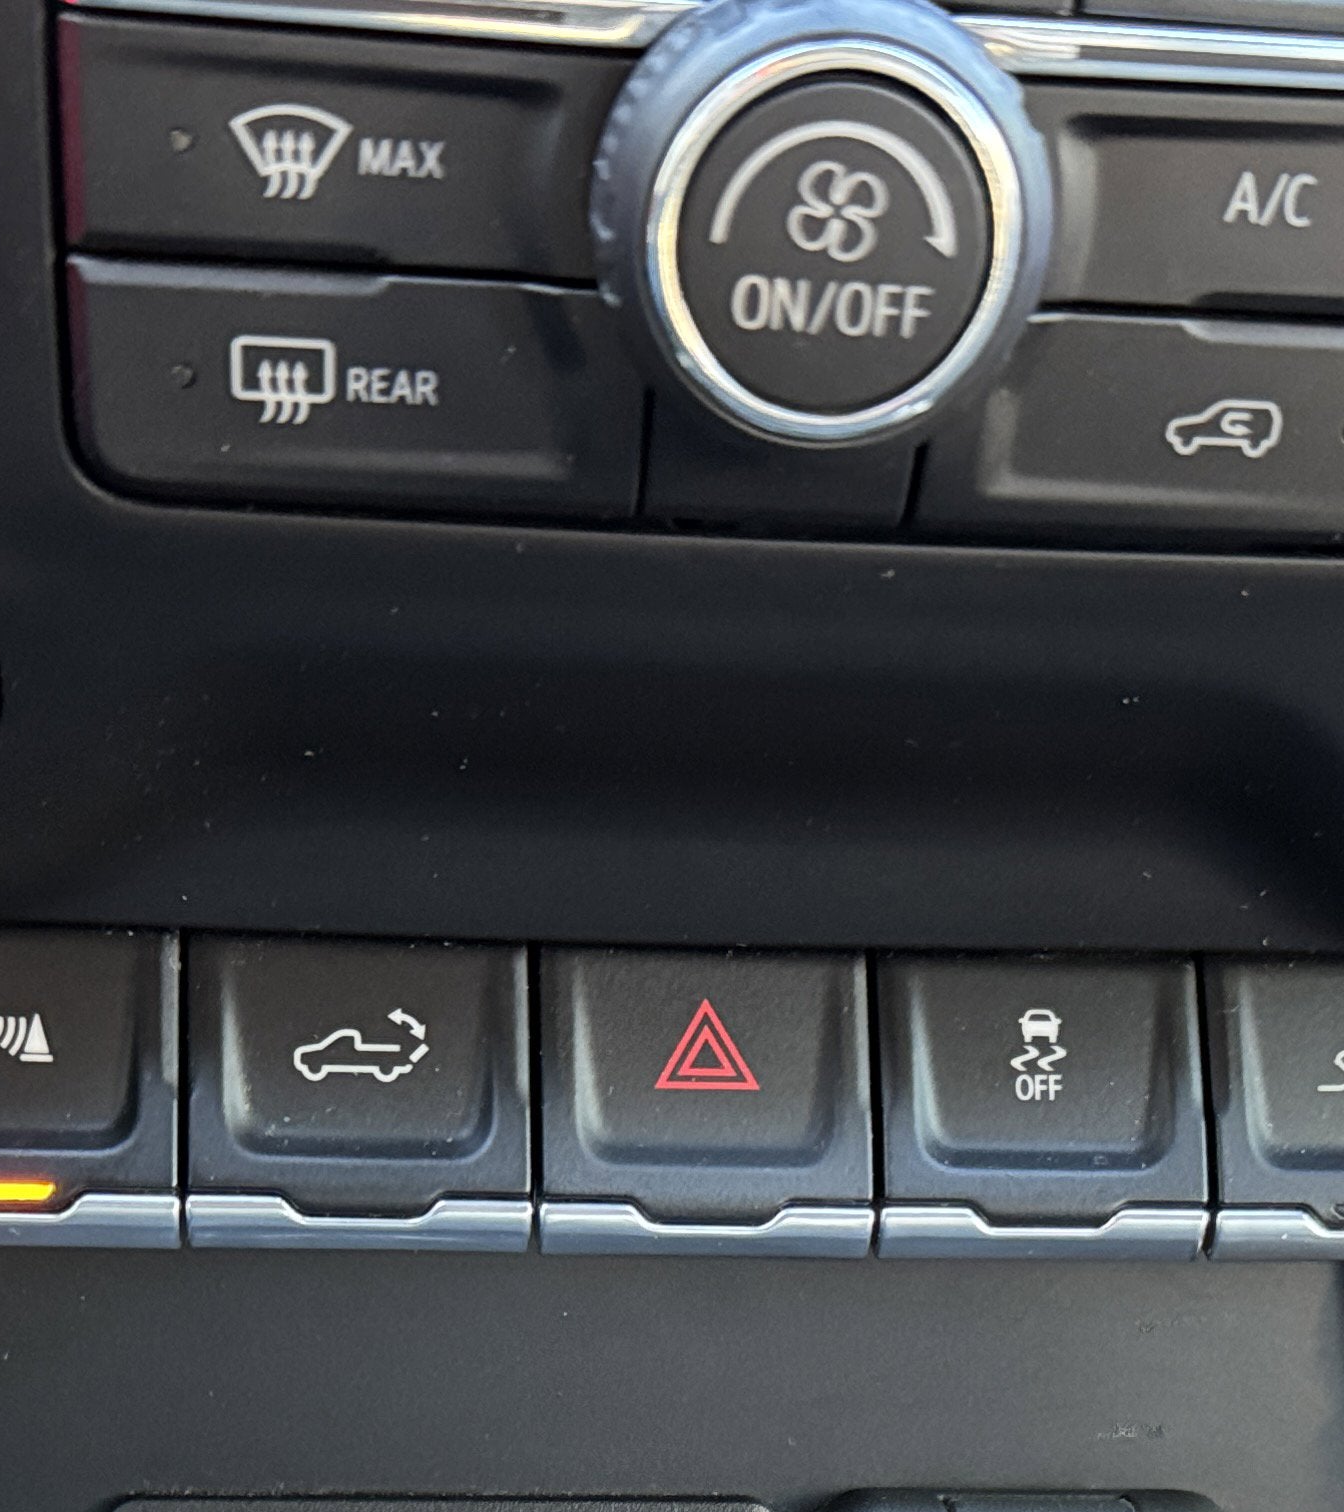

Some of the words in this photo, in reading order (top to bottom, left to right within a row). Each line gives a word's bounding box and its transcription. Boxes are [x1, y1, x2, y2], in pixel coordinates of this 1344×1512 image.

[358, 139, 447, 181] MAX
[1223, 171, 1318, 228] A/C
[730, 273, 937, 340] ON/OFF
[345, 366, 439, 407] REAR
[1013, 1074, 1064, 1103] OFF
